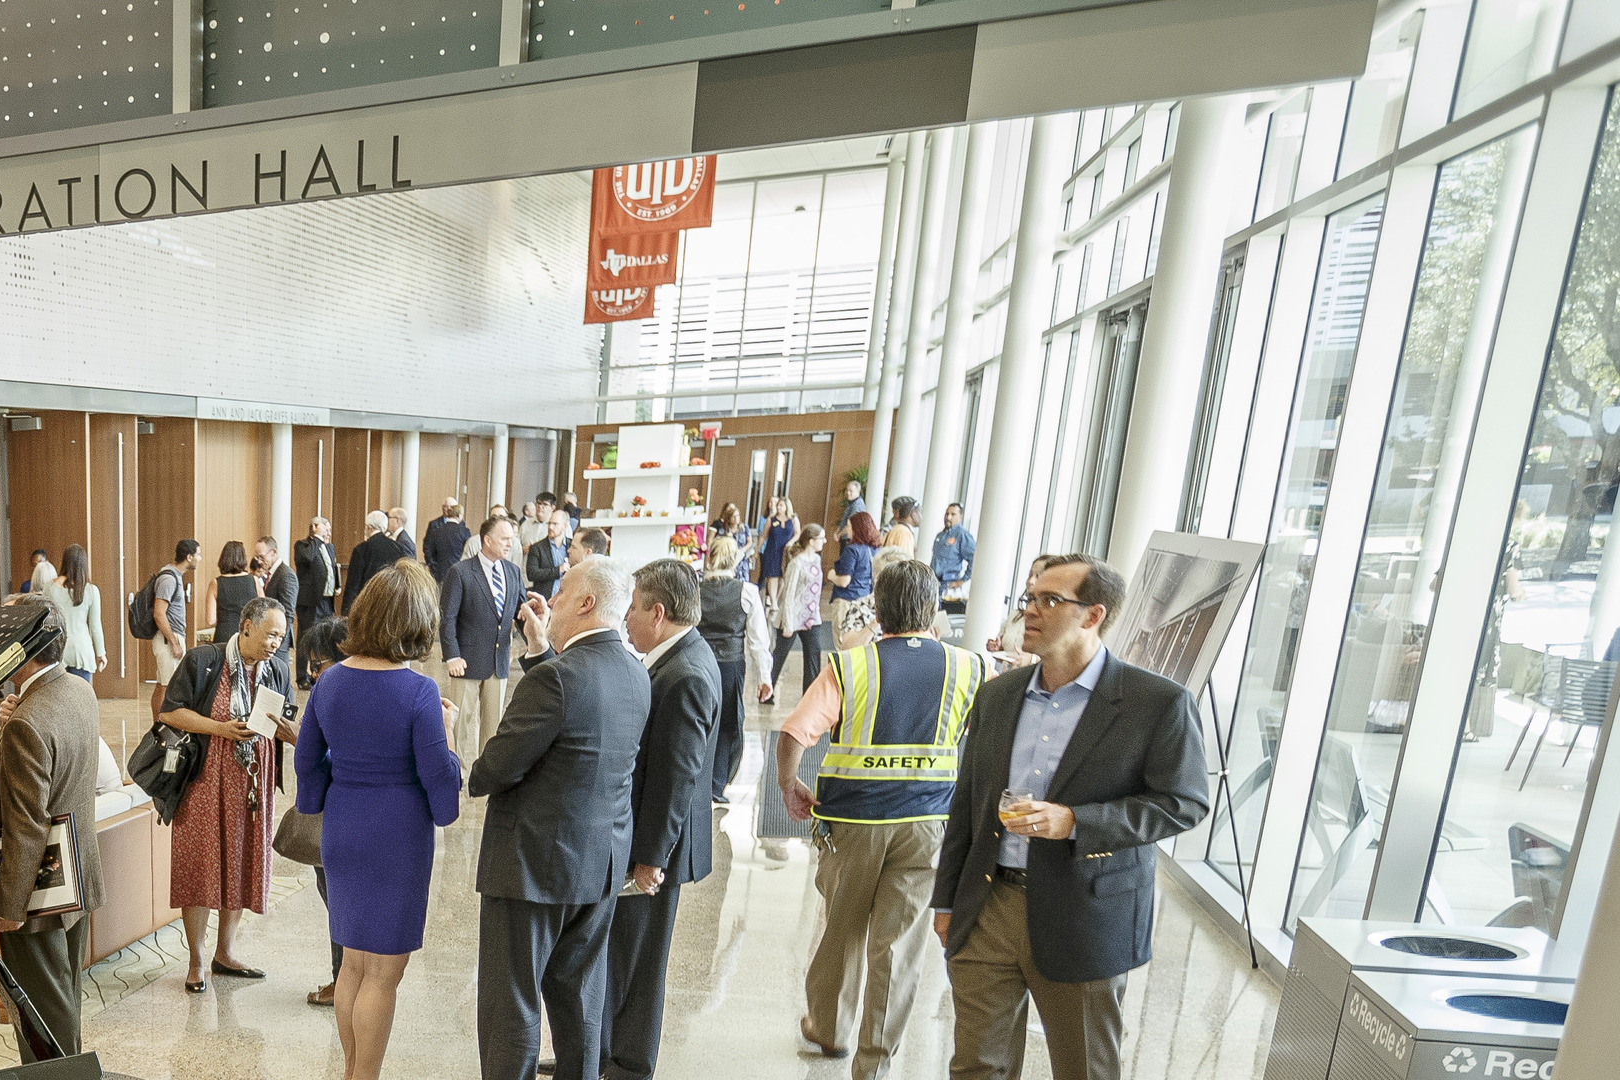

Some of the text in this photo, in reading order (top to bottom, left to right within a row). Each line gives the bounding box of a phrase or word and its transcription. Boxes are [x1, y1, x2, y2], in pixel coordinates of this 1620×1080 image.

[254, 135, 413, 205] HALL
[626, 253, 670, 268] DALLAS
[211, 406, 227, 418] ANN
[230, 407, 245, 421] AND
[863, 756, 937, 769] SAFETY
[1357, 1000, 1396, 1052] Recycle
